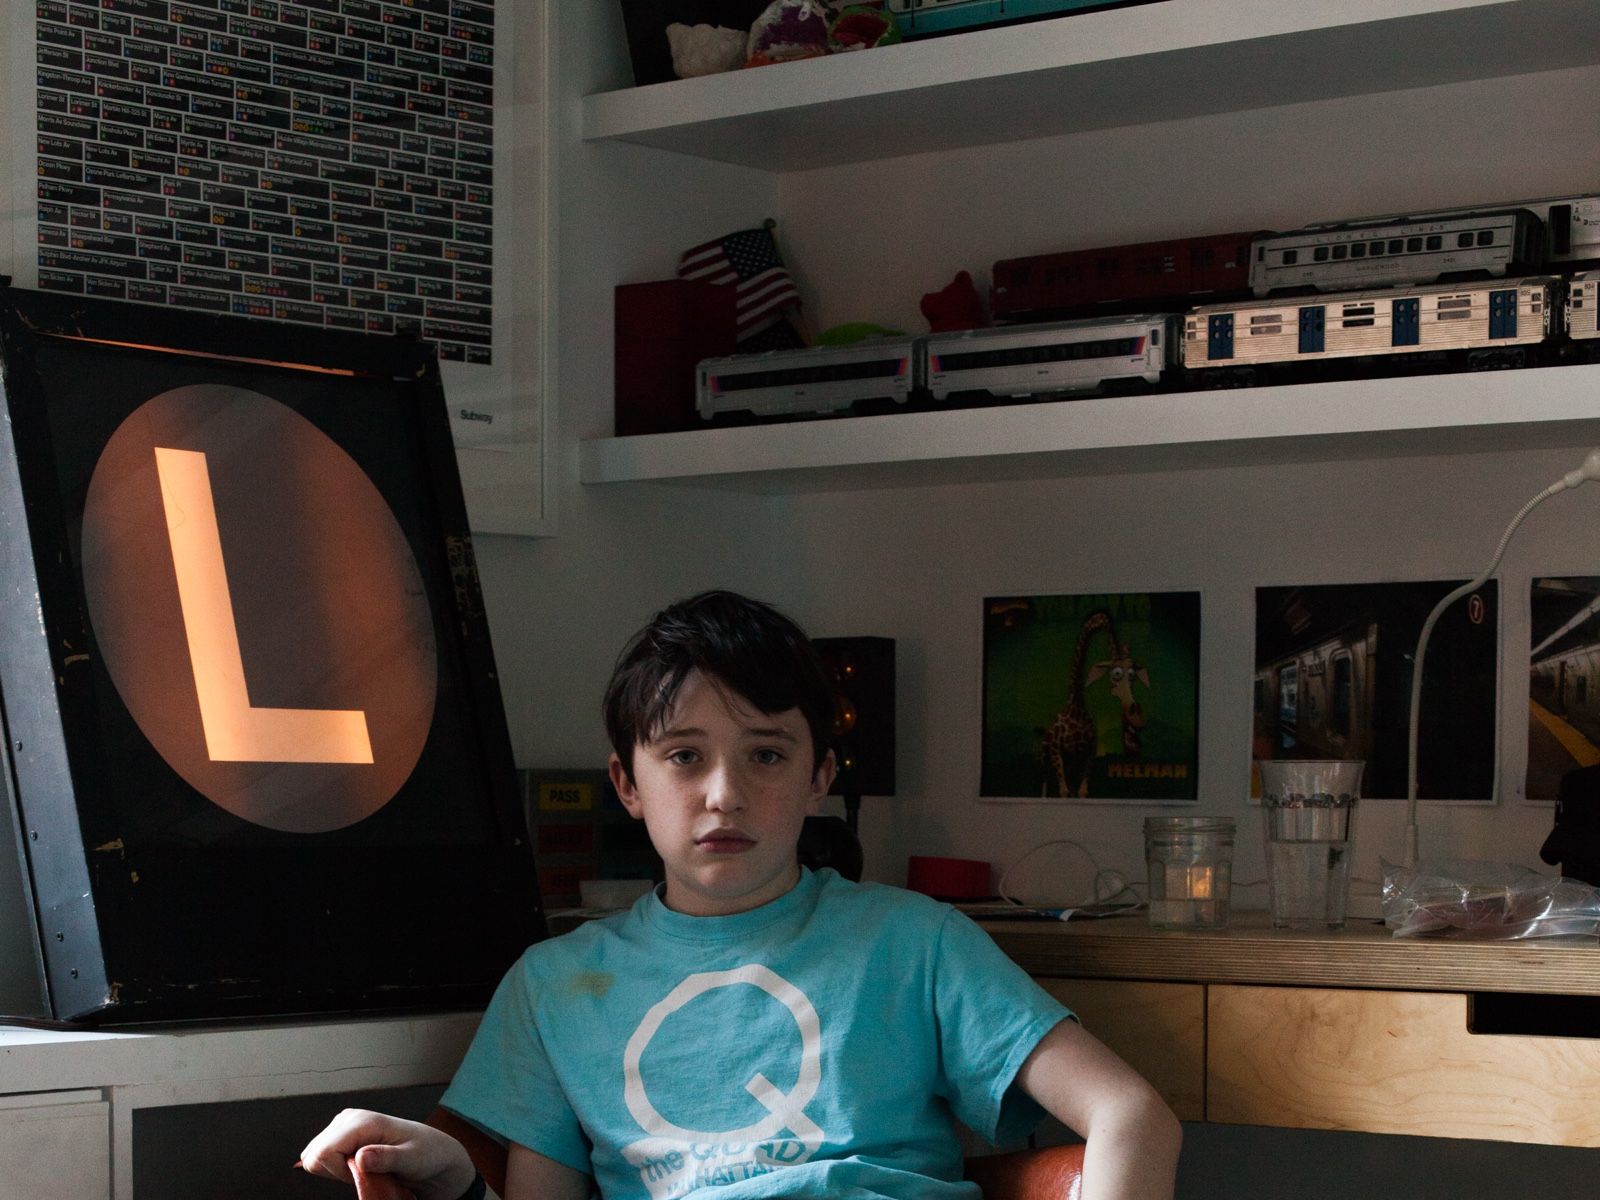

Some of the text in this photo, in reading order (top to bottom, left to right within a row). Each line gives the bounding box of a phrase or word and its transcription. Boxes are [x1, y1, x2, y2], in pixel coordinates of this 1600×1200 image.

[460, 409, 493, 424] Subway
[154, 446, 374, 764] L
[550, 789, 580, 803] PASS
[623, 963, 825, 1142] Q
[642, 1149, 685, 1183] the
